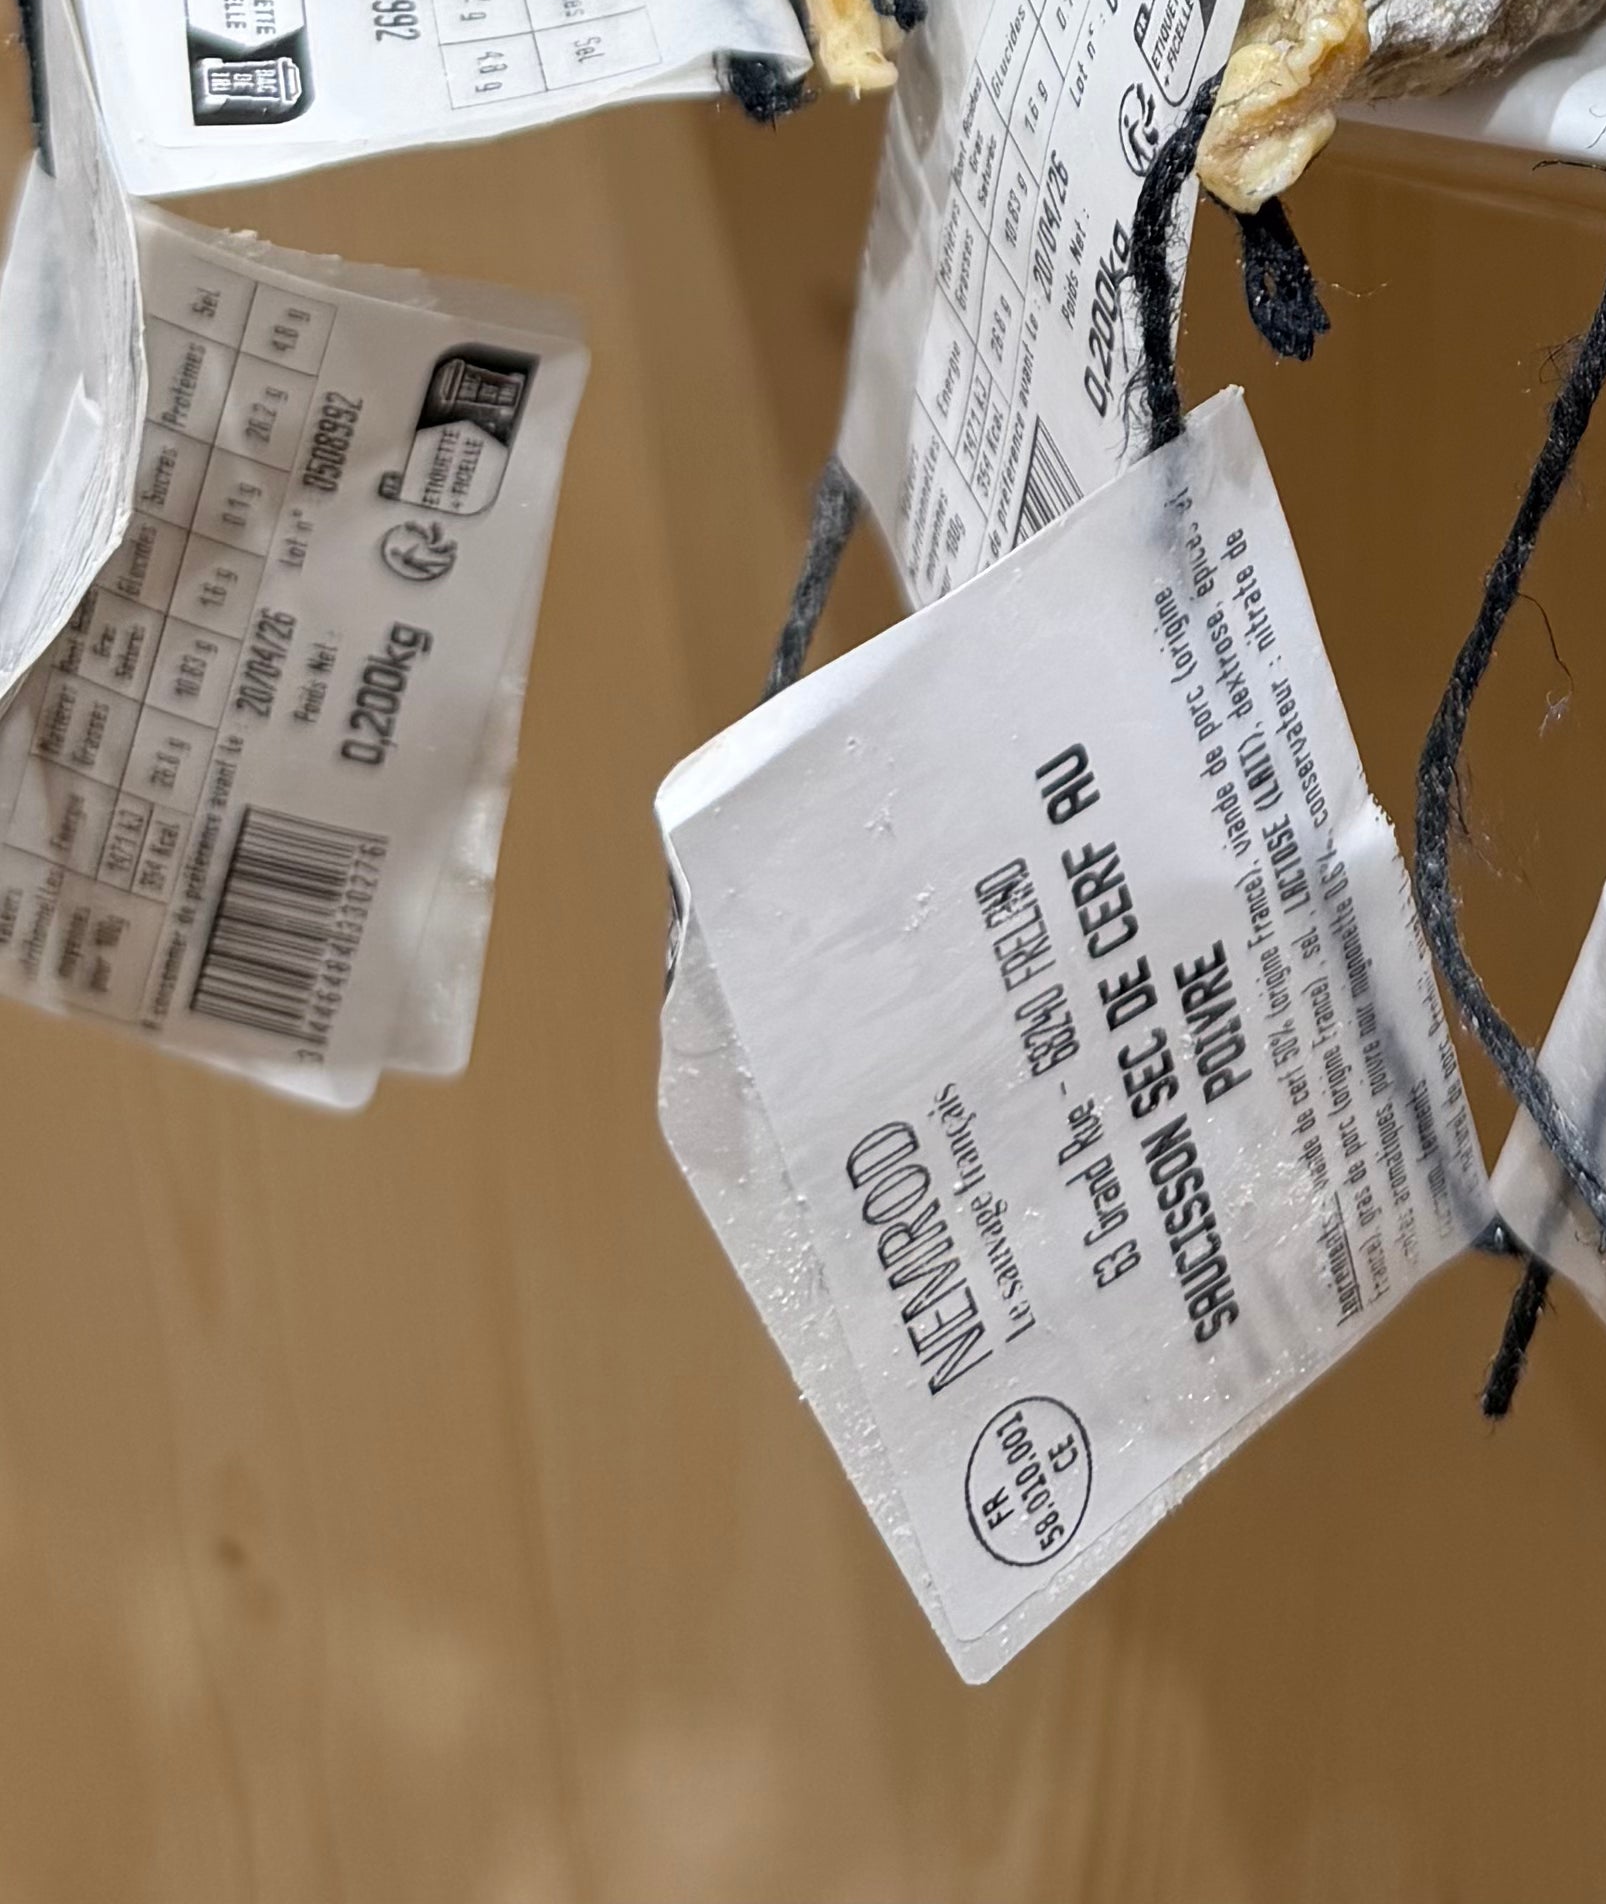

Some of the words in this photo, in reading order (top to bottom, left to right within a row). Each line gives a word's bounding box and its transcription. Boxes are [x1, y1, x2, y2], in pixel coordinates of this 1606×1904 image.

[573, 36, 605, 65] Sel
[987, 4, 1026, 100] Glucides
[1069, 60, 1088, 109] Lot
[1024, 96, 1040, 134] 1.6
[1018, 340, 1034, 409] avant
[1032, 149, 1069, 304] 20/04/26
[1069, 218, 1087, 266] Net
[1060, 268, 1079, 331] Poids
[232, 607, 297, 719] 20/04/26
[300, 391, 364, 494] 0508992
[1220, 528, 1248, 561] de
[1153, 586, 1198, 684] (origine
[1232, 564, 1276, 653] nitrate
[339, 621, 433, 768] 0,200kg
[1206, 600, 1254, 720] dextrose,
[1186, 684, 1222, 743] porc
[1035, 743, 1101, 826] AU
[1199, 745, 1228, 778] de
[1237, 720, 1284, 812] (LAIT),
[1271, 677, 1329, 829] conservateur
[1211, 781, 1252, 858] viande
[1061, 841, 1139, 960] CERF
[1261, 813, 1311, 915] LACTOSE
[974, 857, 1056, 993] FRELAND
[1290, 925, 1321, 961] sel
[1329, 896, 1372, 1001] mignonette
[1097, 955, 1158, 1033] DE
[1255, 945, 1292, 1020] (origine
[1300, 975, 1338, 1052] France)
[1347, 1001, 1378, 1040] noir
[1014, 983, 1081, 1078] 68240
[1173, 939, 1253, 1106] POIVRE
[1267, 1018, 1301, 1070] 50%
[1117, 1027, 1180, 1120] SEC
[1277, 1064, 1310, 1108] cerf
[1319, 1044, 1353, 1118] (origine
[1359, 1039, 1395, 1099] poivre
[927, 1082, 986, 1199] français
[1057, 1098, 1104, 1167] Rue
[1290, 1107, 1317, 1136] de
[1338, 1115, 1367, 1160] porc
[1065, 1153, 1130, 1248] Grand
[1342, 1159, 1368, 1187] de
[1353, 1185, 1381, 1228] gras
[845, 1121, 994, 1397] NEMROD
[970, 1194, 1022, 1301] sauvage
[1092, 1238, 1142, 1289] 63
[1140, 1113, 1240, 1344] SAUCISSON
[1004, 1299, 1037, 1344] Le
[995, 1410, 1065, 1552] 58.010.001
[1047, 1433, 1079, 1474] CE
[981, 1486, 1015, 1531] FR
